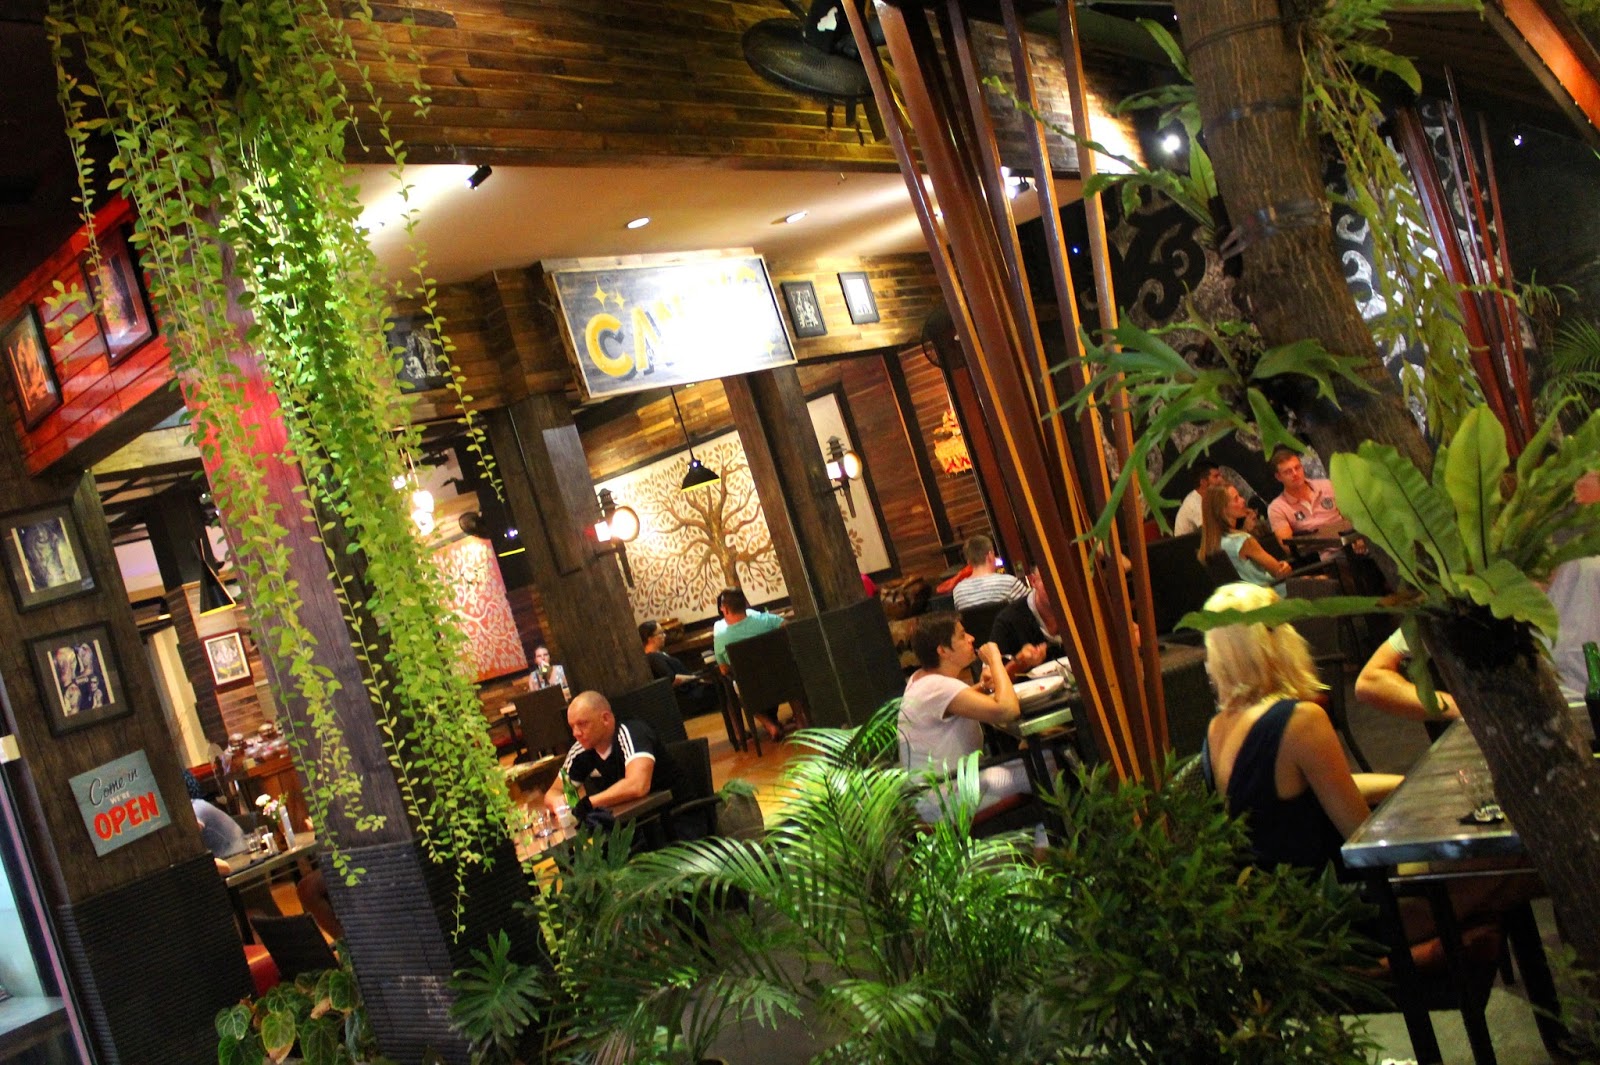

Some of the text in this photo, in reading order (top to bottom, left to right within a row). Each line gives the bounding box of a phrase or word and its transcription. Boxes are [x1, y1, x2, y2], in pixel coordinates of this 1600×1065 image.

[89, 768, 138, 807] Come in
[93, 791, 160, 841] OPEN
